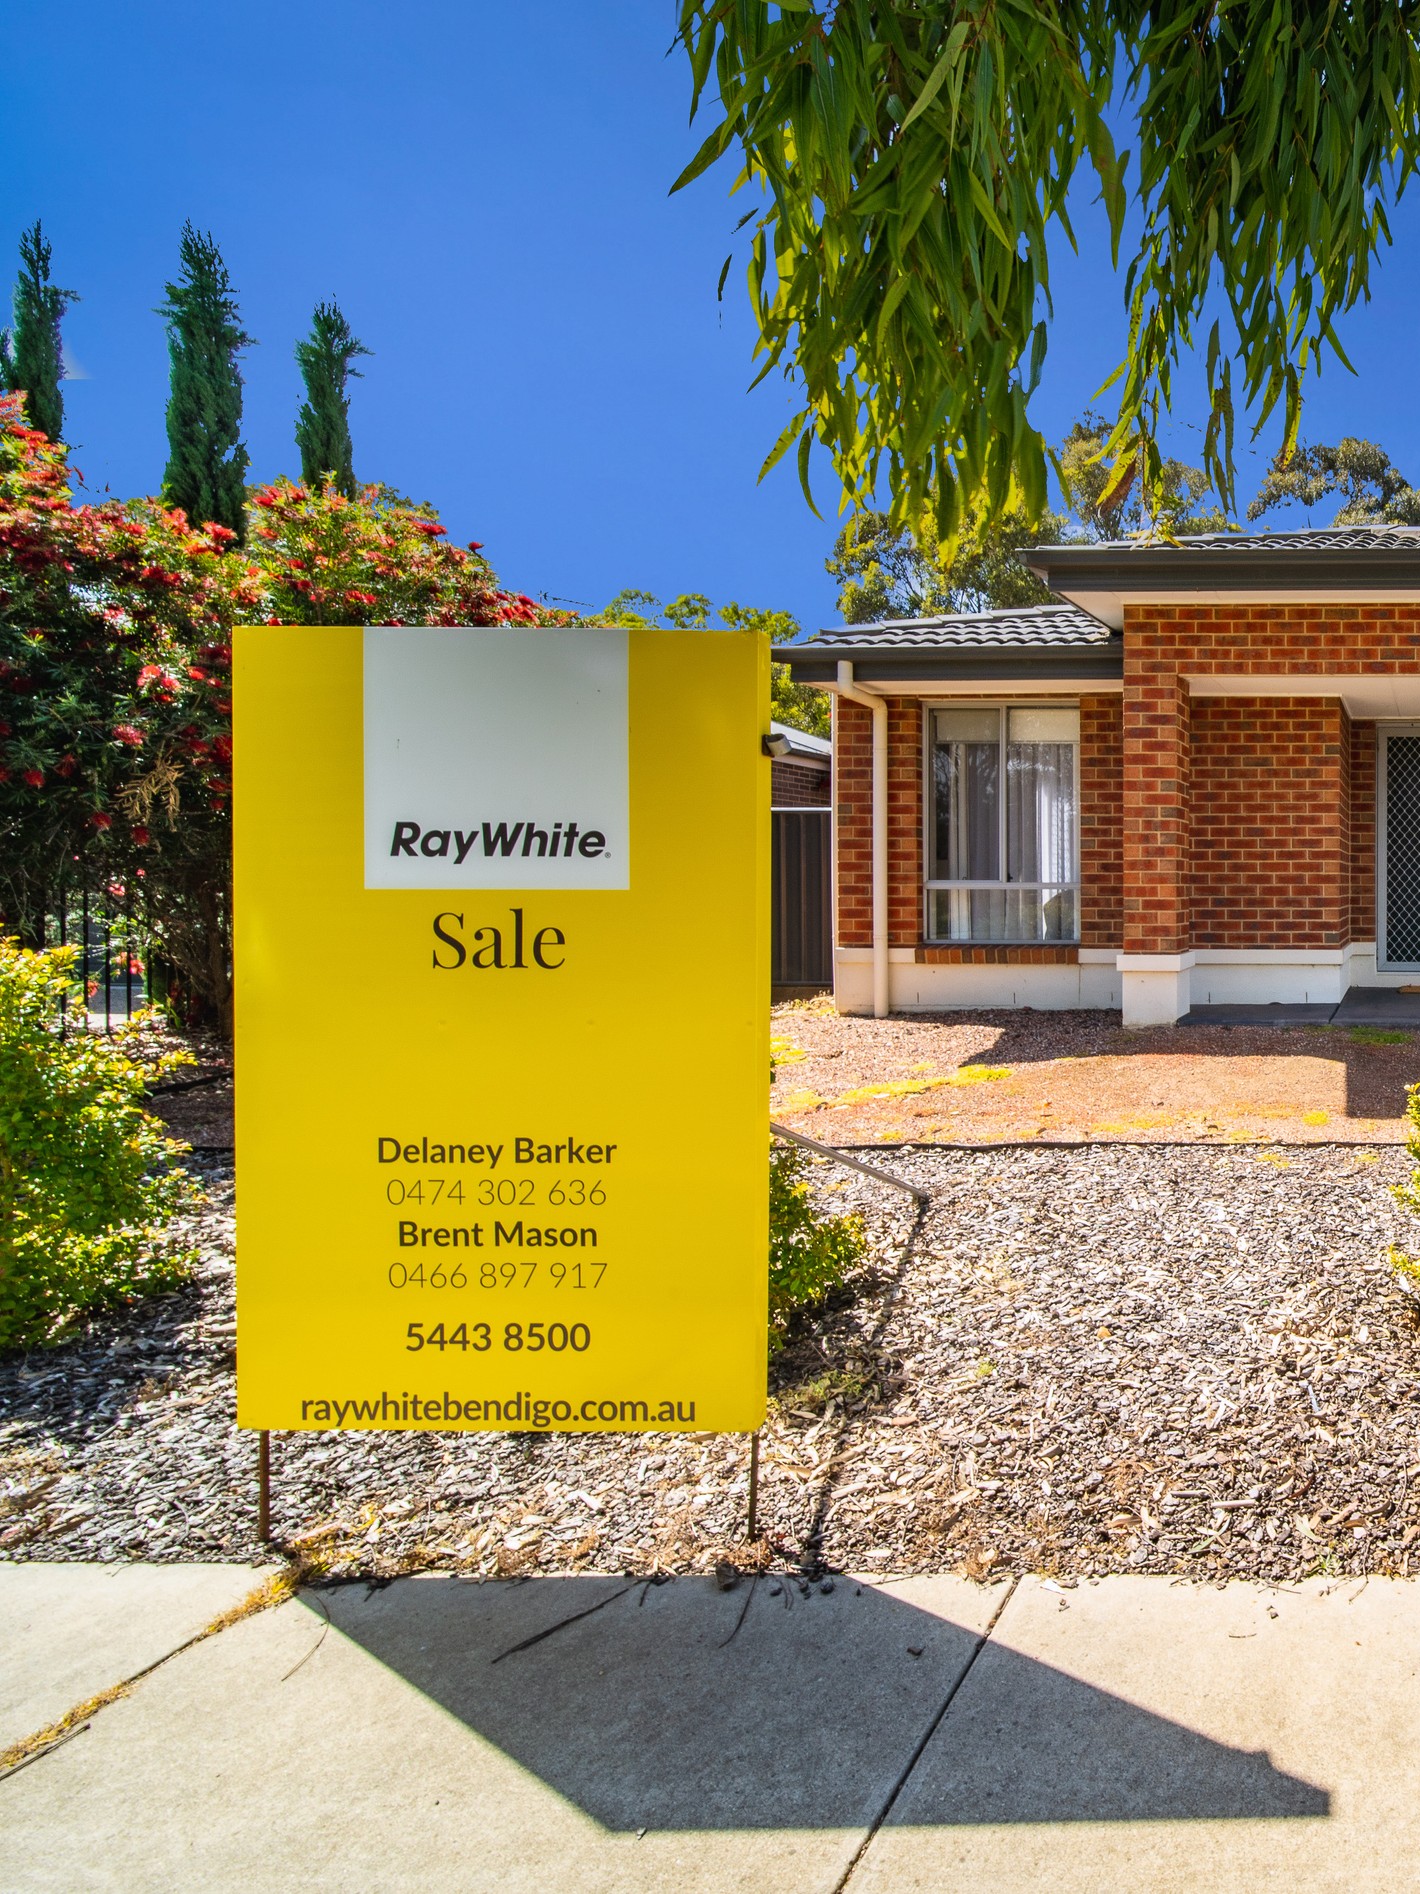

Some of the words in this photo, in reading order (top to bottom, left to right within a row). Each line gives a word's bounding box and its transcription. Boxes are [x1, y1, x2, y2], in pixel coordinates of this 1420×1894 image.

[432, 907, 566, 970] Sale
[377, 1136, 504, 1170] Delaney
[514, 1136, 618, 1164] Barker
[386, 1179, 466, 1206] 0474
[477, 1179, 536, 1206] 302
[548, 1179, 607, 1206] 636
[398, 1220, 484, 1248] Brent
[494, 1220, 598, 1248] Mason
[388, 1262, 468, 1289] 0466
[479, 1262, 538, 1289] 897
[549, 1262, 608, 1289] 917
[405, 1322, 492, 1352] 5443
[503, 1322, 591, 1353] 8500
[301, 1391, 696, 1429] raywhitebendigo.com.au
